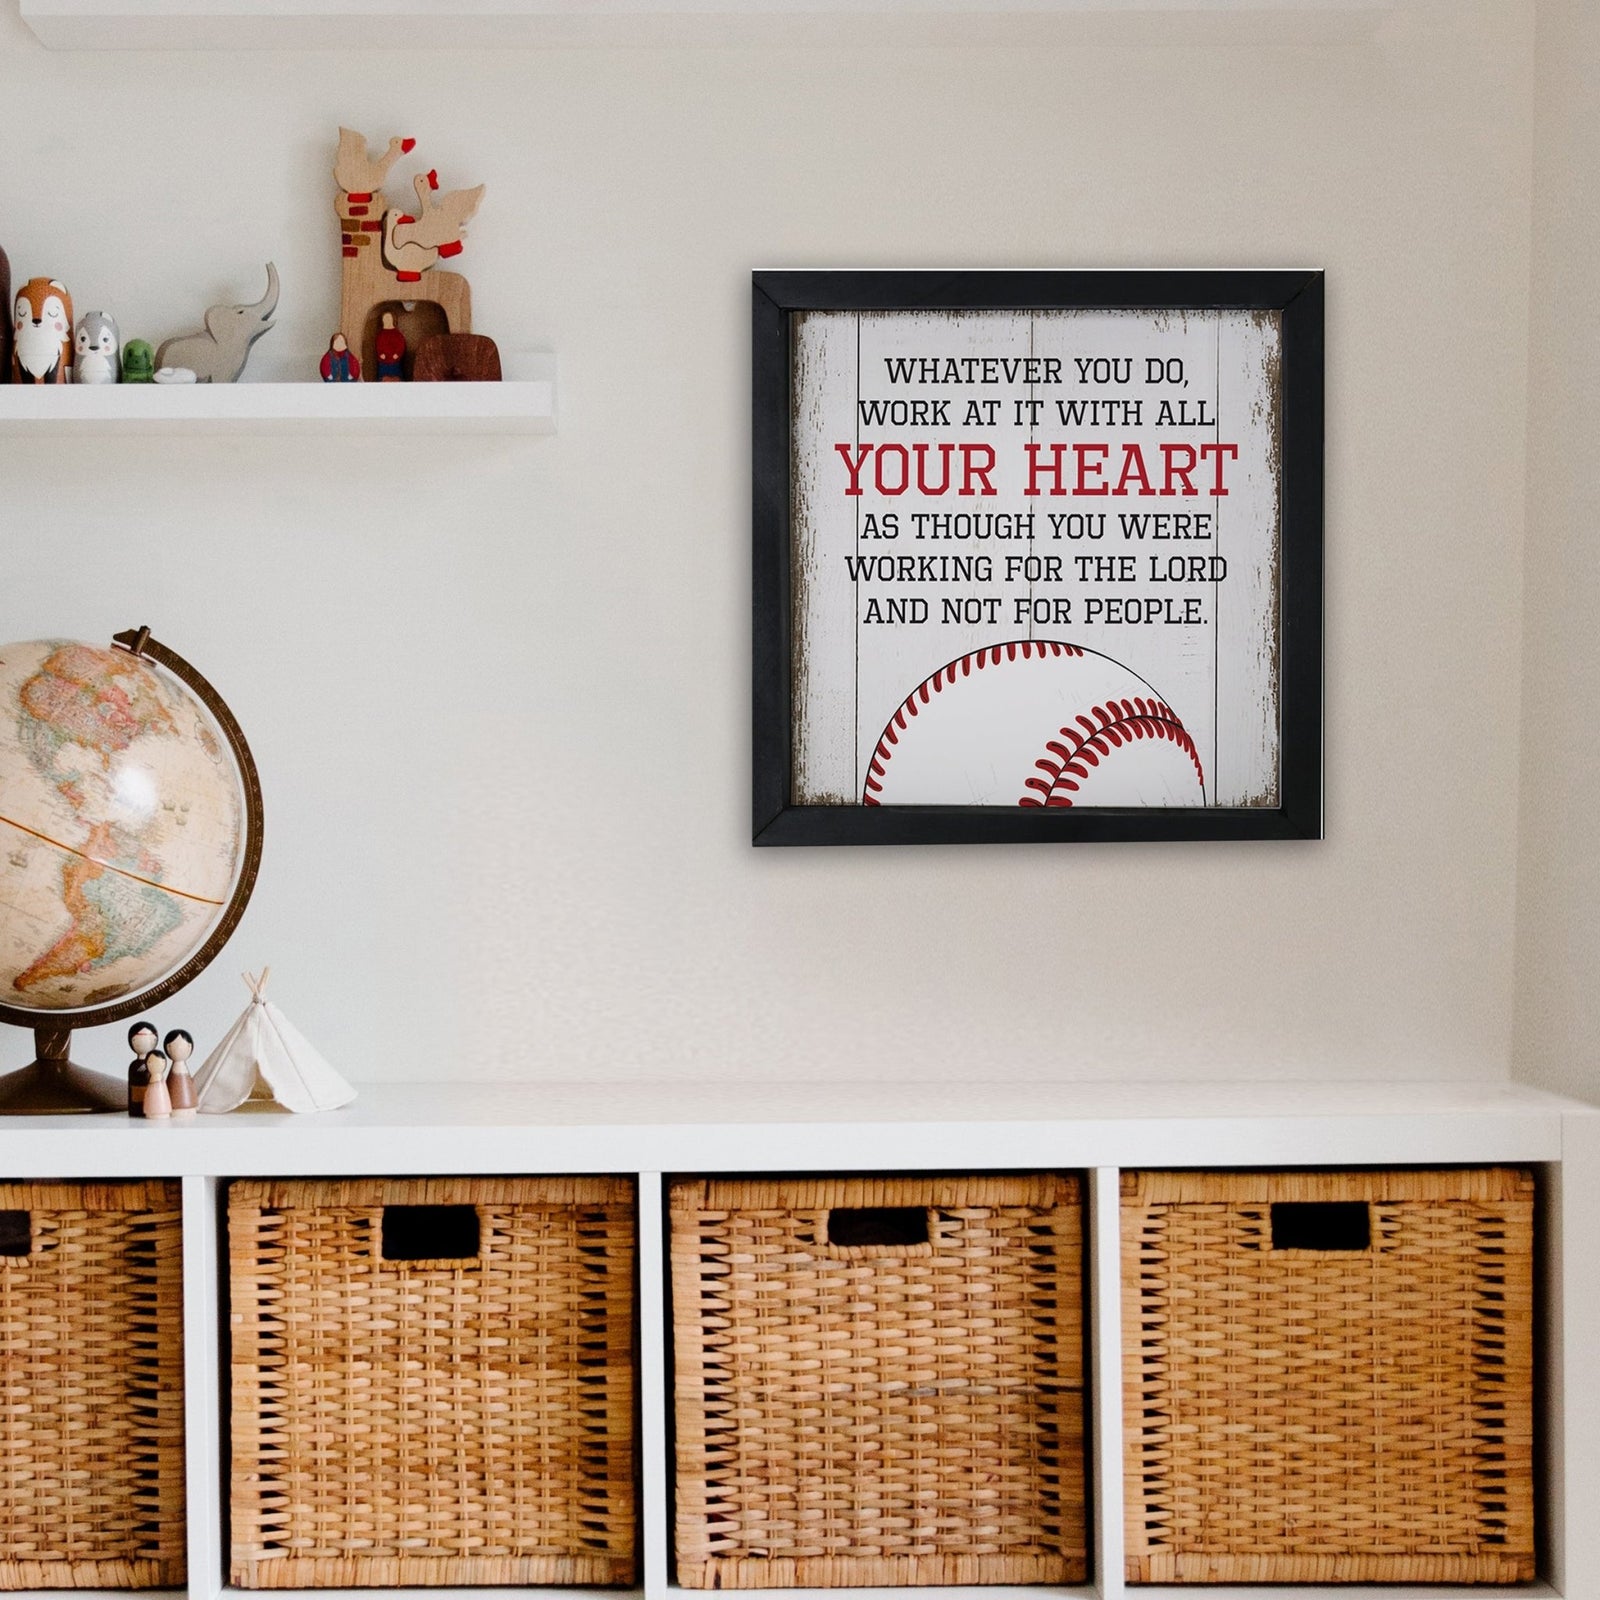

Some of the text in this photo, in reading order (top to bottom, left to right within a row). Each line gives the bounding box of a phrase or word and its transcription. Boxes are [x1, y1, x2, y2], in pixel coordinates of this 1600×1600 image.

[884, 358, 1189, 388] WHATEVER YOU DO,
[859, 401, 1215, 426] WORK AT IT WITH ALL
[835, 444, 1237, 495] YOUR HEART
[861, 514, 1212, 539] AS THOUGH YOU WERE
[845, 556, 1228, 582] WORKING FOR THE LORD
[864, 599, 1208, 624] AND NOT FOR PEOPLE.
